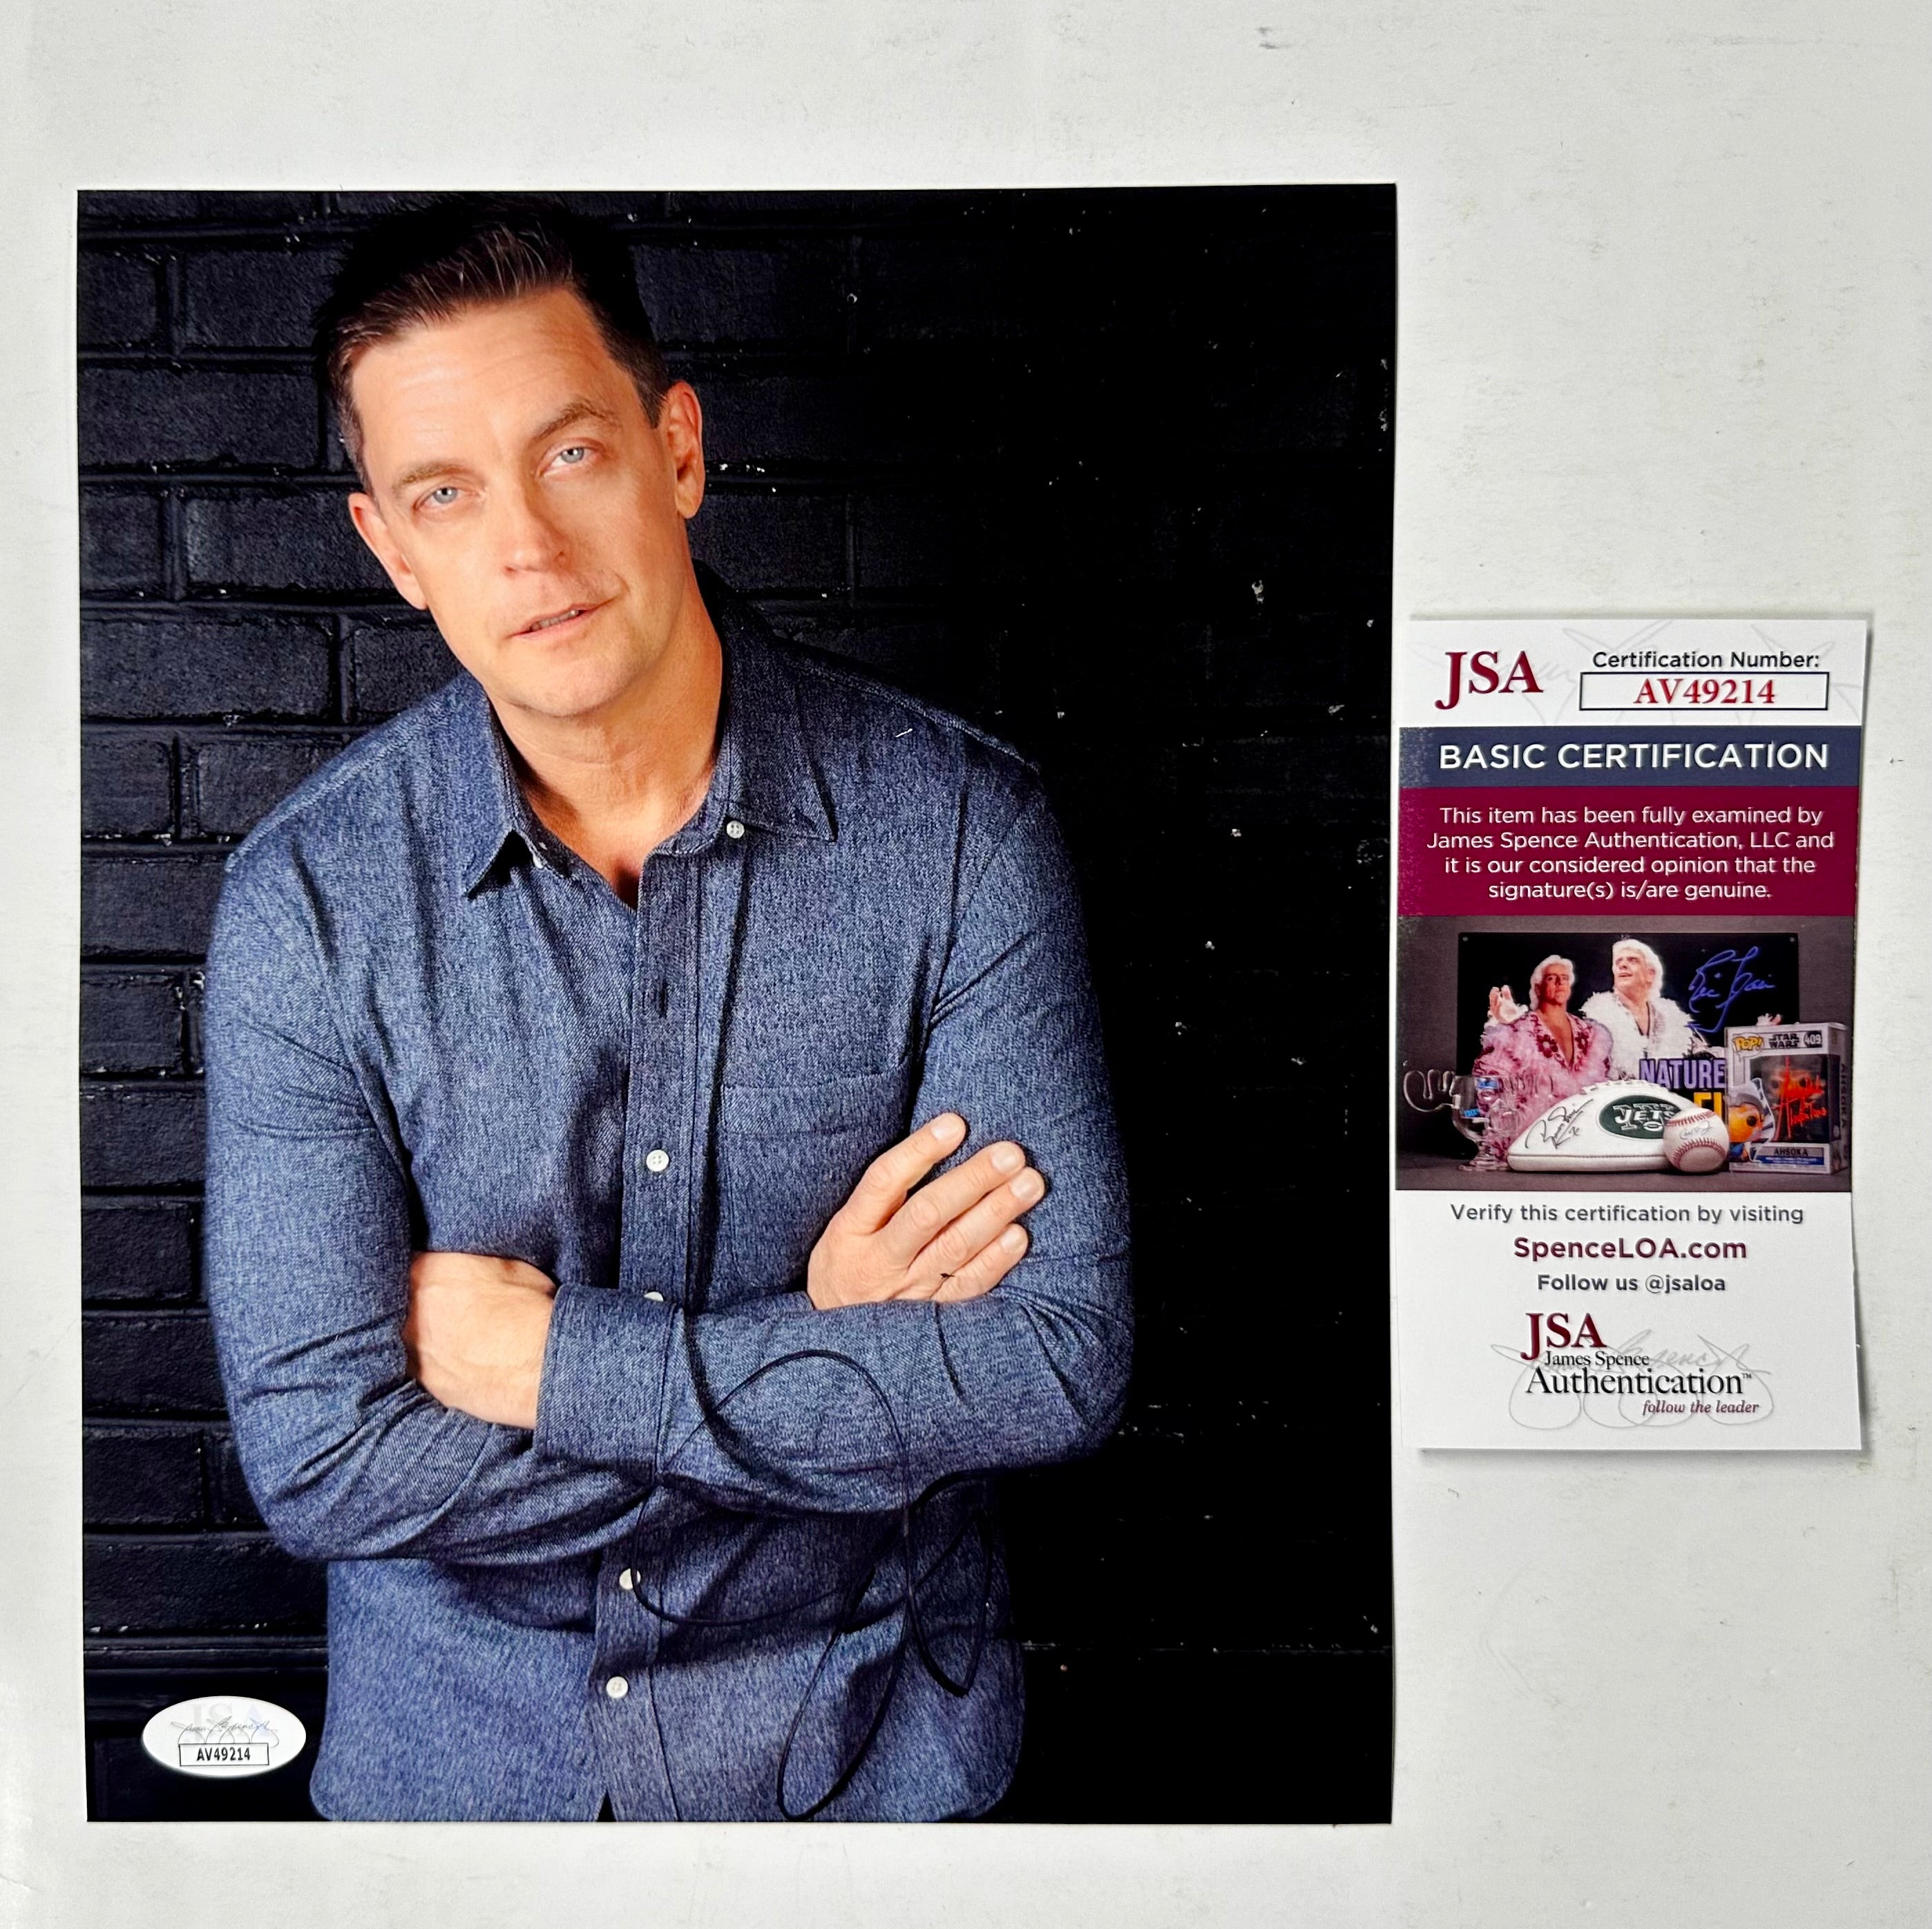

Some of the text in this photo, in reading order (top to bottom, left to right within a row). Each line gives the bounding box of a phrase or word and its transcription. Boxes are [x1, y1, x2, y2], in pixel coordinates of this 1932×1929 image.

[1592, 651, 1819, 668] Certification Number:
[1434, 650, 1544, 710] JSA
[1633, 678, 1775, 704] AV49214
[1440, 741, 1828, 769] BASIC CERTIFICATION
[1439, 806, 1823, 826] This item has been fully examined by
[1426, 830, 1834, 851] James Spence Authentication, LLC and
[1445, 856, 1816, 876] it is our considered opinion that the
[1489, 880, 1771, 901] signature(s) is/are genuine.
[1732, 1036, 1764, 1052] POP!
[1805, 1034, 1821, 1045] 409
[1639, 1059, 1726, 1090] NATURE
[1773, 1147, 1808, 1157] AHSOKA
[1450, 1204, 1804, 1225] Verify this certification by visiting
[1514, 1237, 1747, 1262] SpenceLOA.com
[1538, 1273, 1725, 1294] Follow us @jsaloa
[1520, 1312, 1607, 1361] JSA
[1544, 1351, 1649, 1369] James Spence
[1643, 1399, 1760, 1416] follow the leader
[196, 1747, 251, 1761] AV49214
